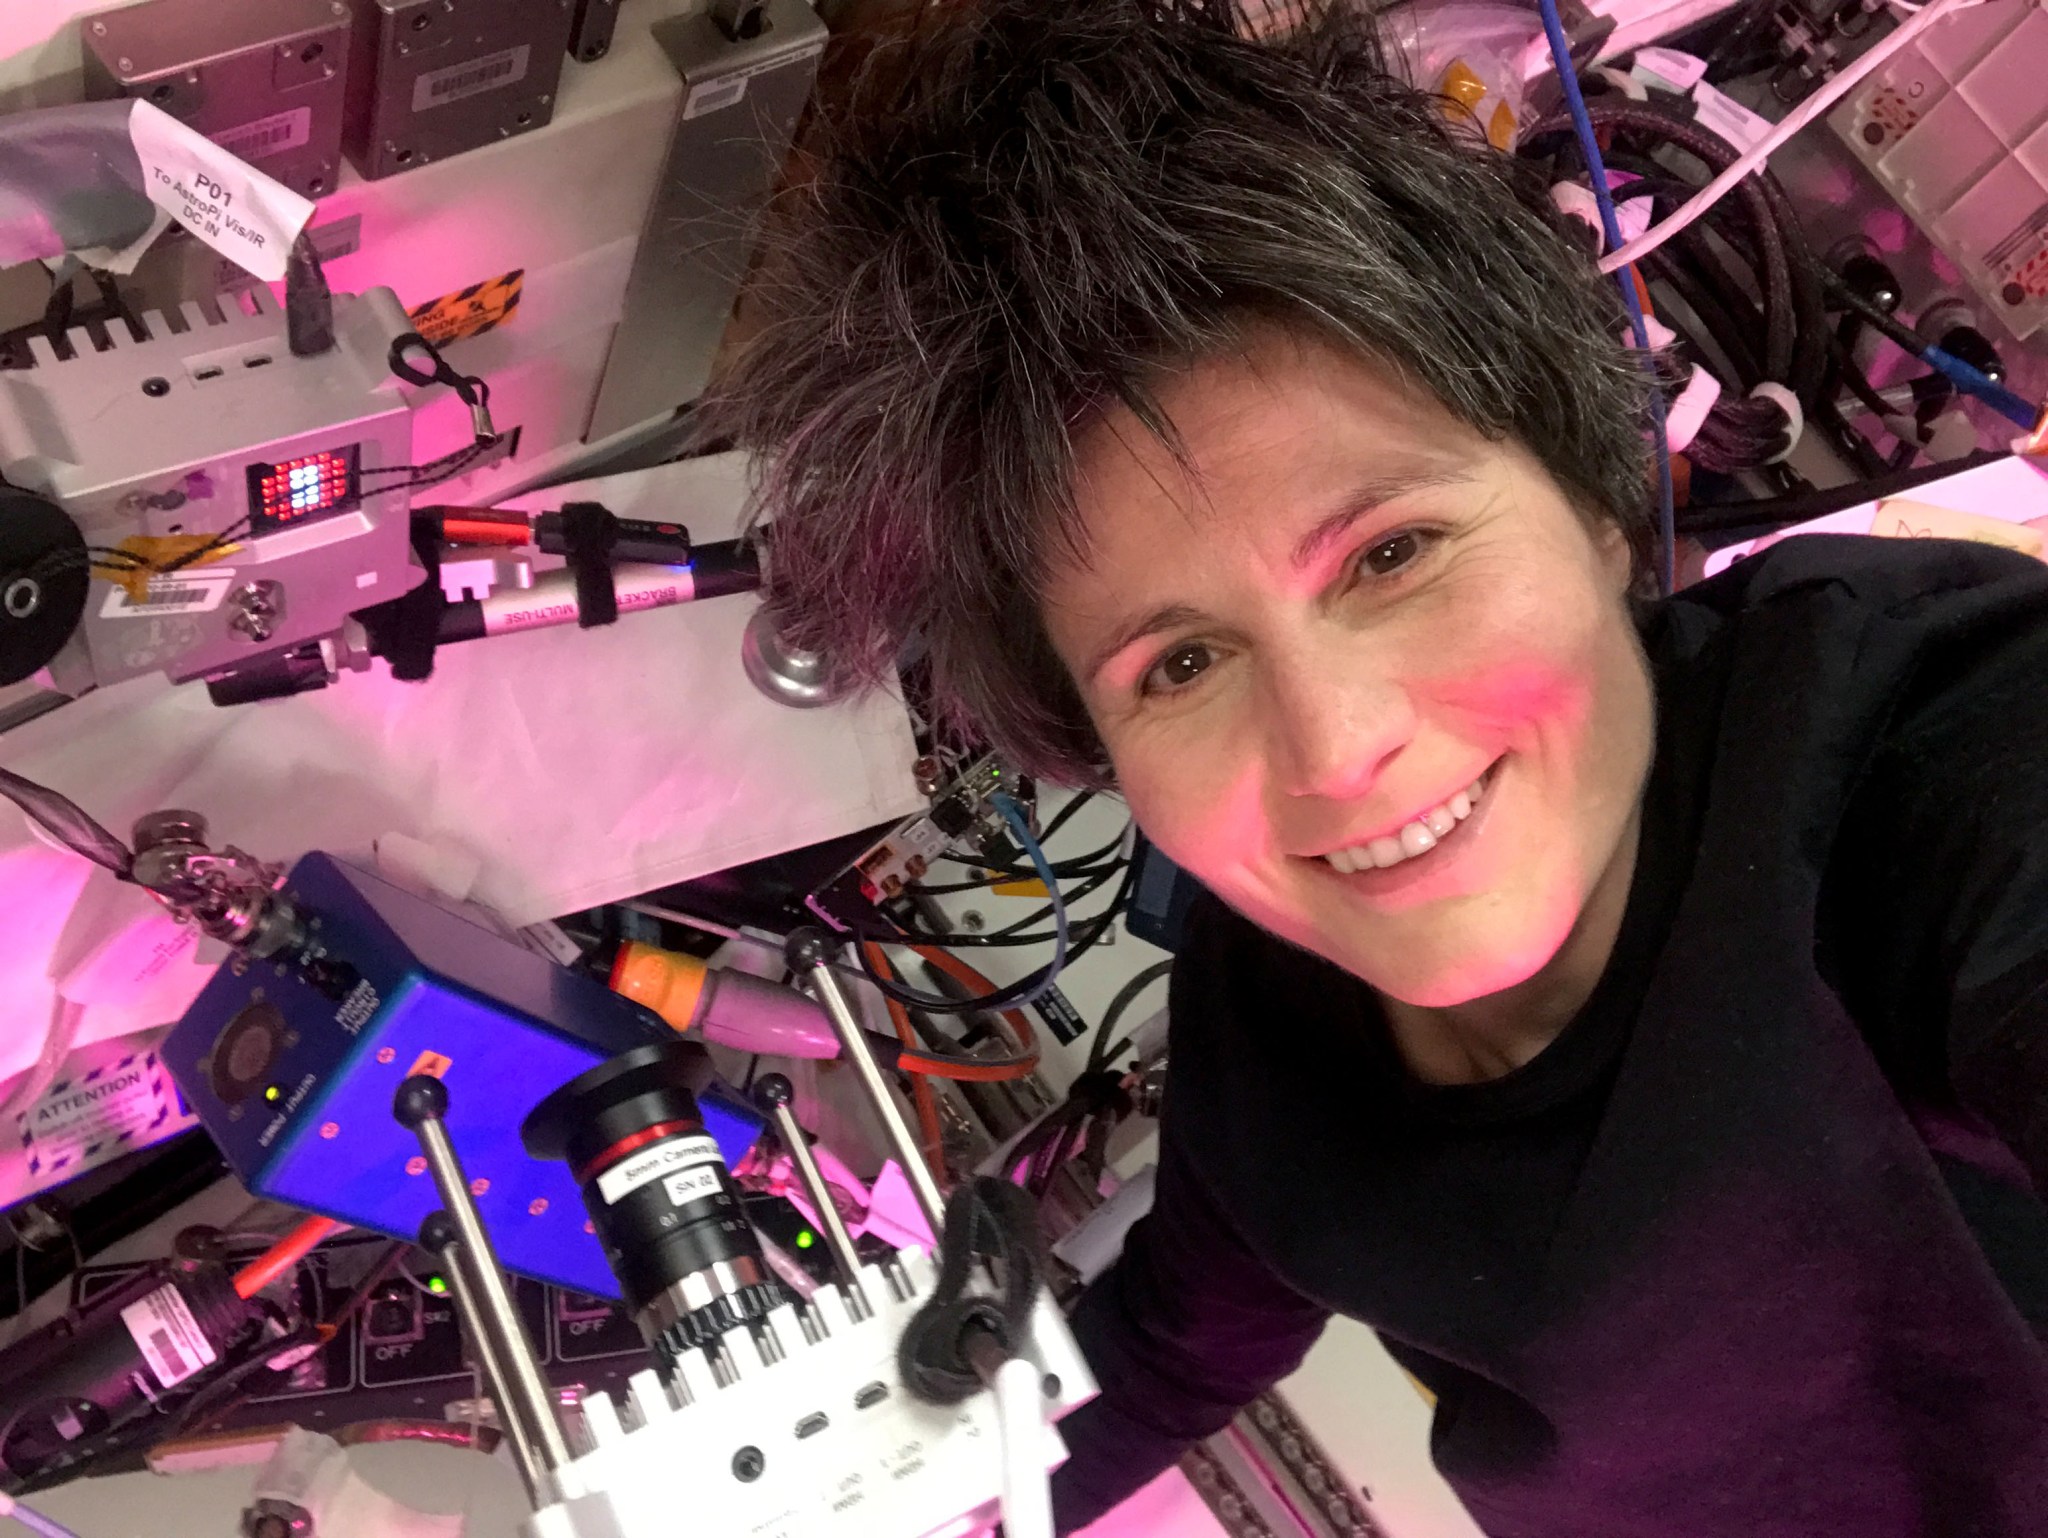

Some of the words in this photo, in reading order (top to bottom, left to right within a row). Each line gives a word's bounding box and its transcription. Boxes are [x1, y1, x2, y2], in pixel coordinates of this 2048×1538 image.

[195, 173, 232, 207] P01
[153, 166, 172, 185] To
[173, 181, 222, 221] AstroPi
[225, 214, 266, 249] Vis/IR
[183, 204, 203, 225] DC
[204, 220, 220, 238] IN
[504, 603, 574, 625] MULTI-USE
[38, 1071, 140, 1122] ATTENTION
[675, 1180, 696, 1195] SN
[569, 1318, 606, 1336] OFF
[375, 1343, 414, 1361] OFF
